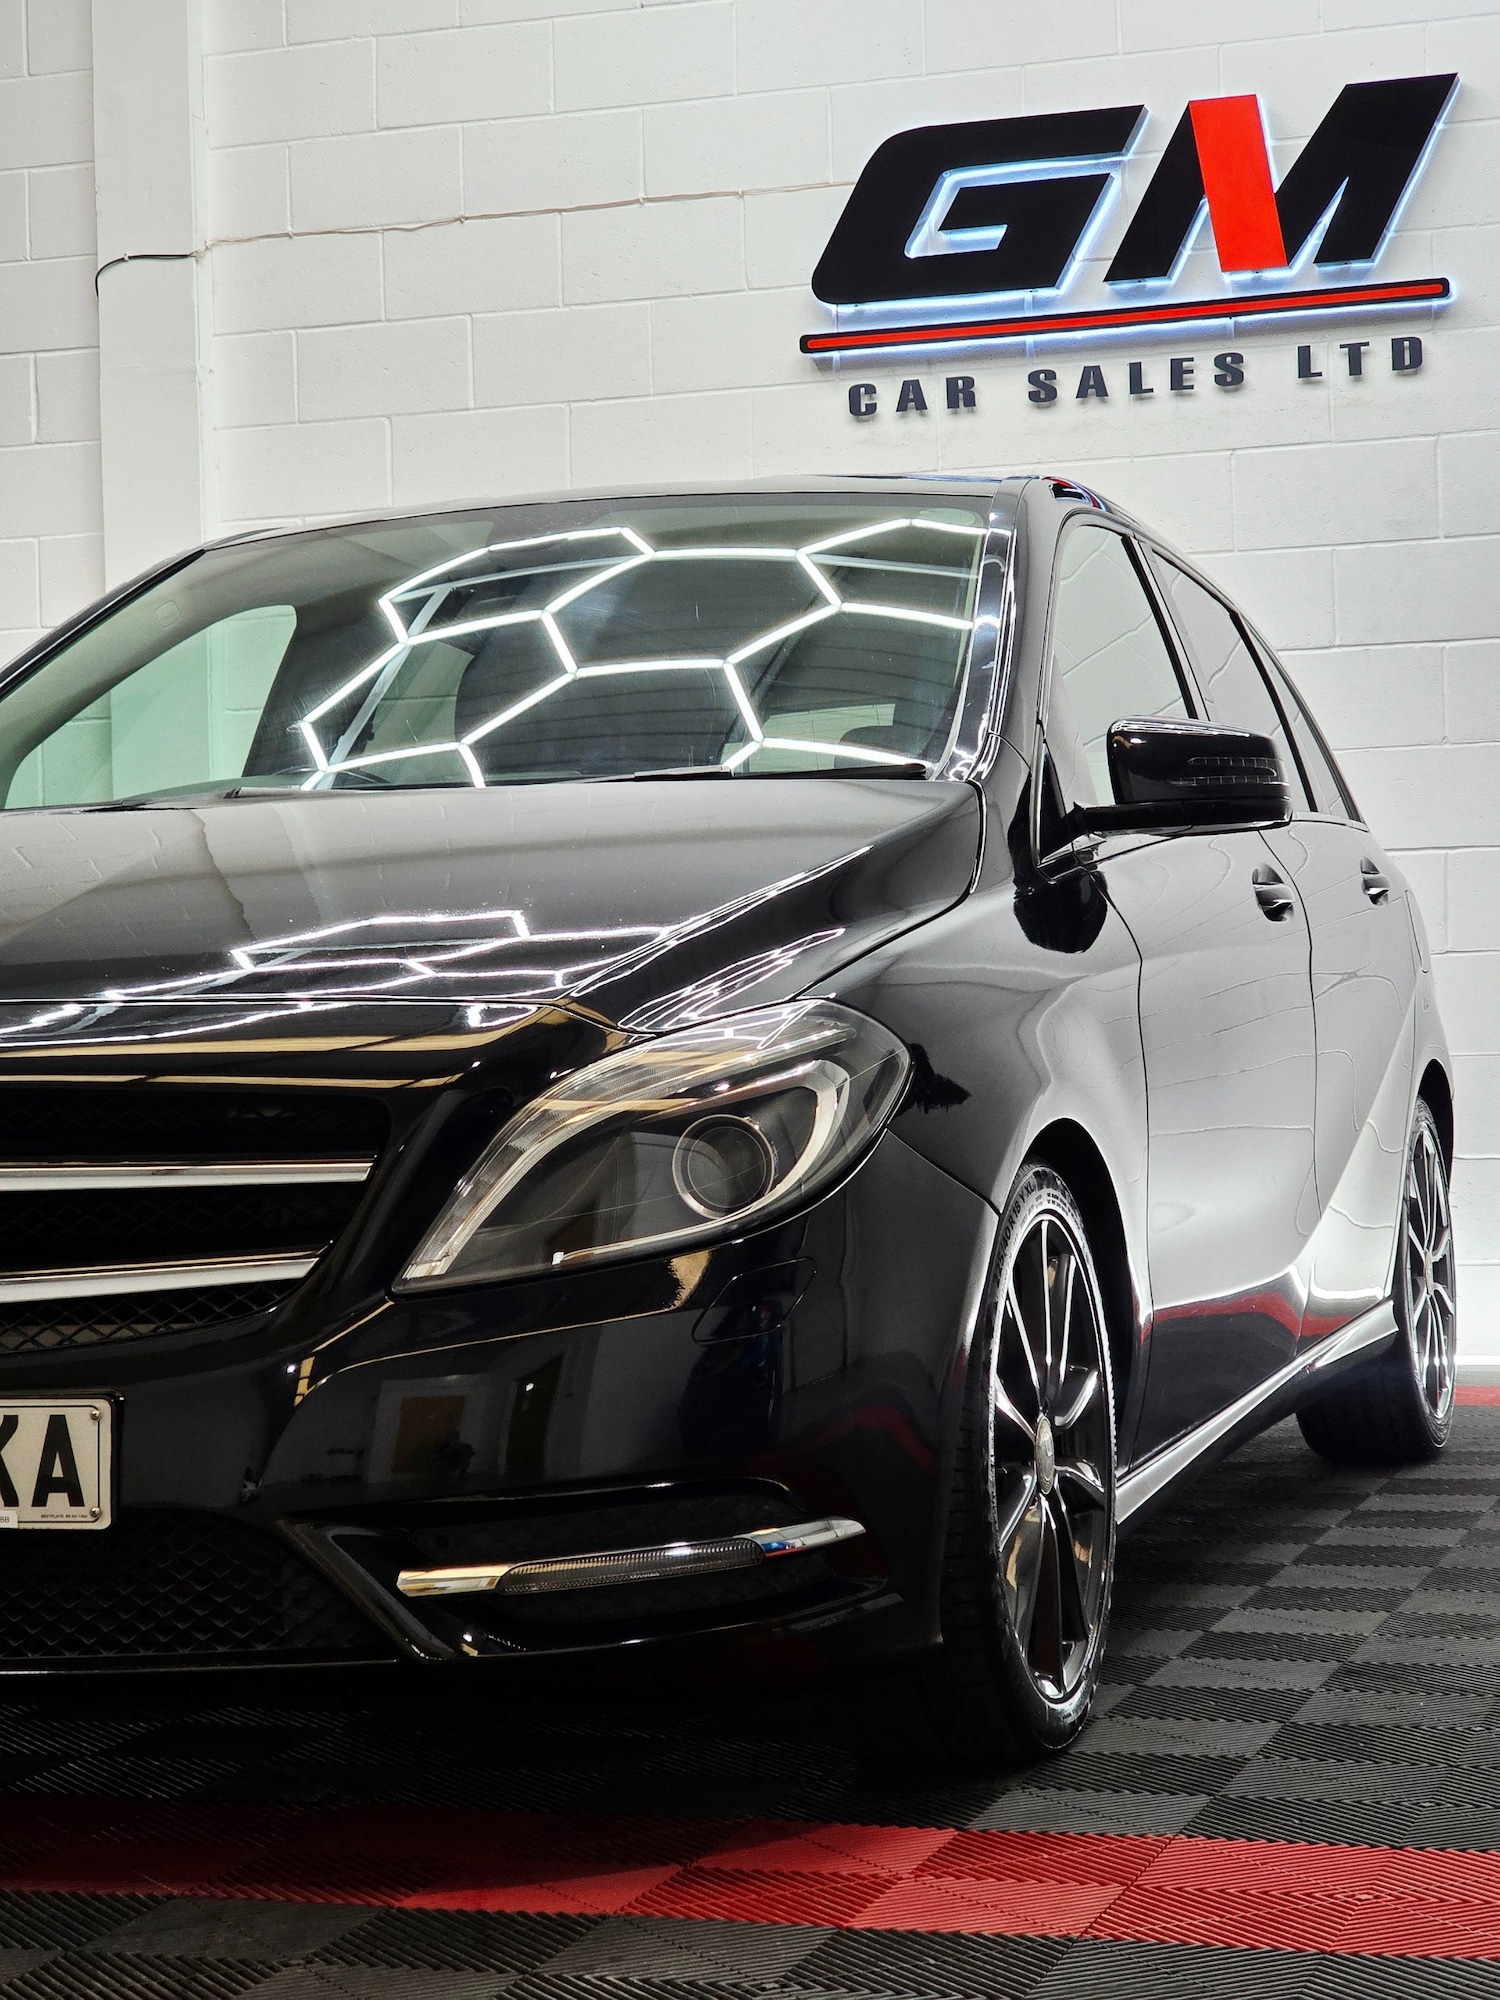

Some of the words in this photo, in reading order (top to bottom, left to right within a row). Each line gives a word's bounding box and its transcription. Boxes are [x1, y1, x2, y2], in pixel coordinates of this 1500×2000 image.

[811, 73, 1458, 305] GM
[848, 376, 977, 417] CAR
[1027, 352, 1244, 403] SALES
[1297, 336, 1423, 379] LTD
